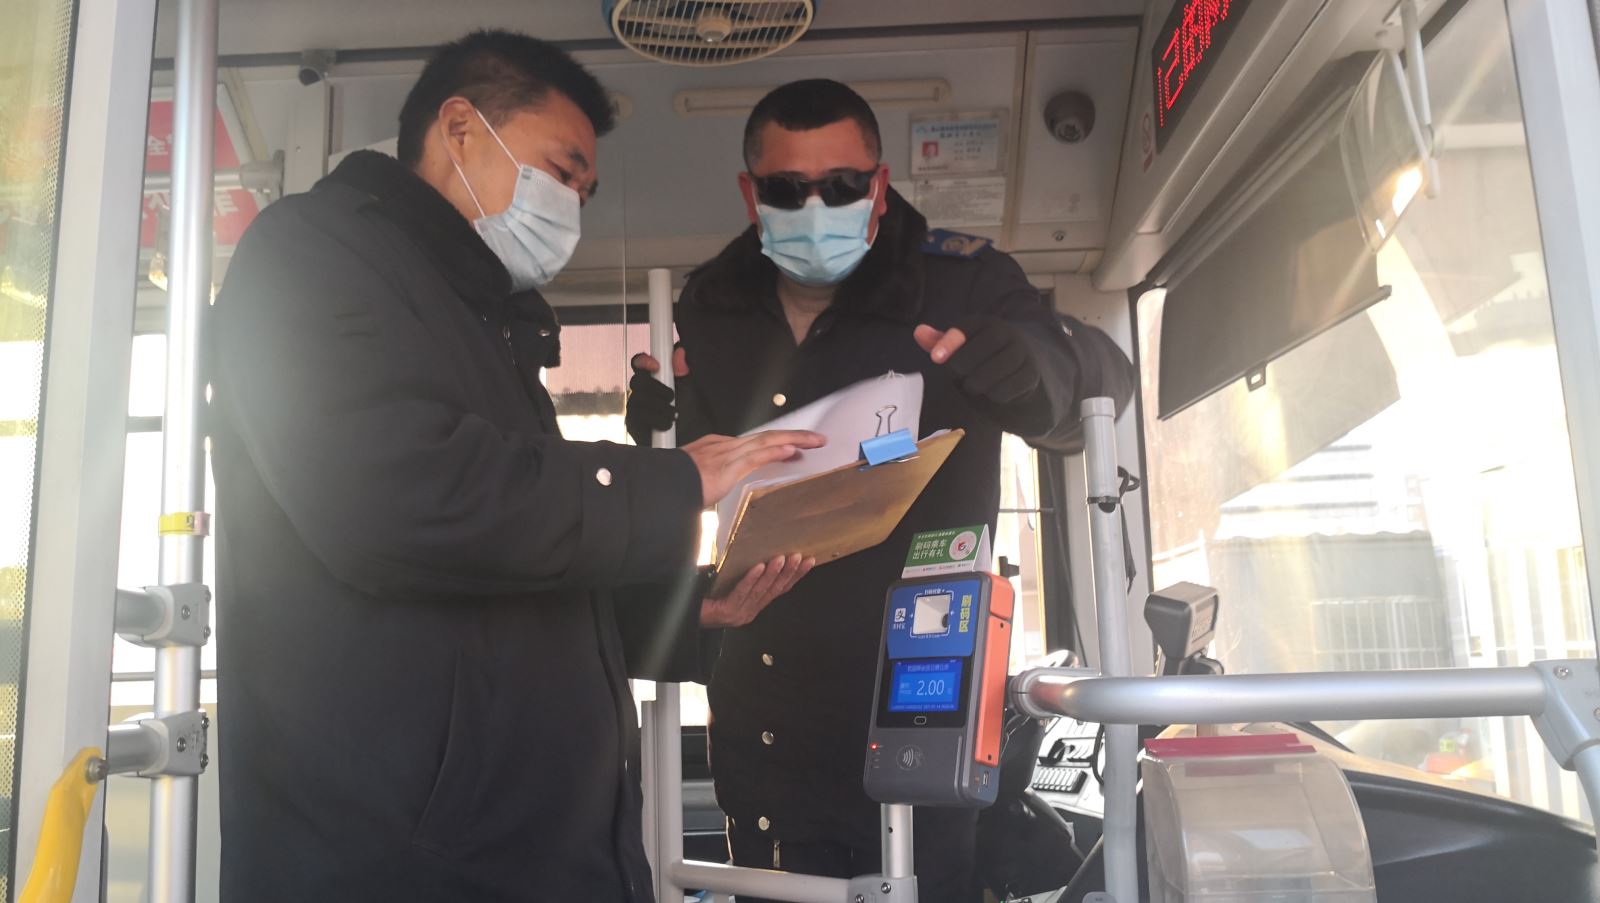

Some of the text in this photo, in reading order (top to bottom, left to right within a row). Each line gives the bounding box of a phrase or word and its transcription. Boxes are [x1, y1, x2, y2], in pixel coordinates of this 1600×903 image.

[914, 539, 947, 550] 刷码乘车
[912, 548, 944, 560] 出行有礼
[958, 594, 972, 633] 刷码区
[916, 679, 945, 696] 2.00
